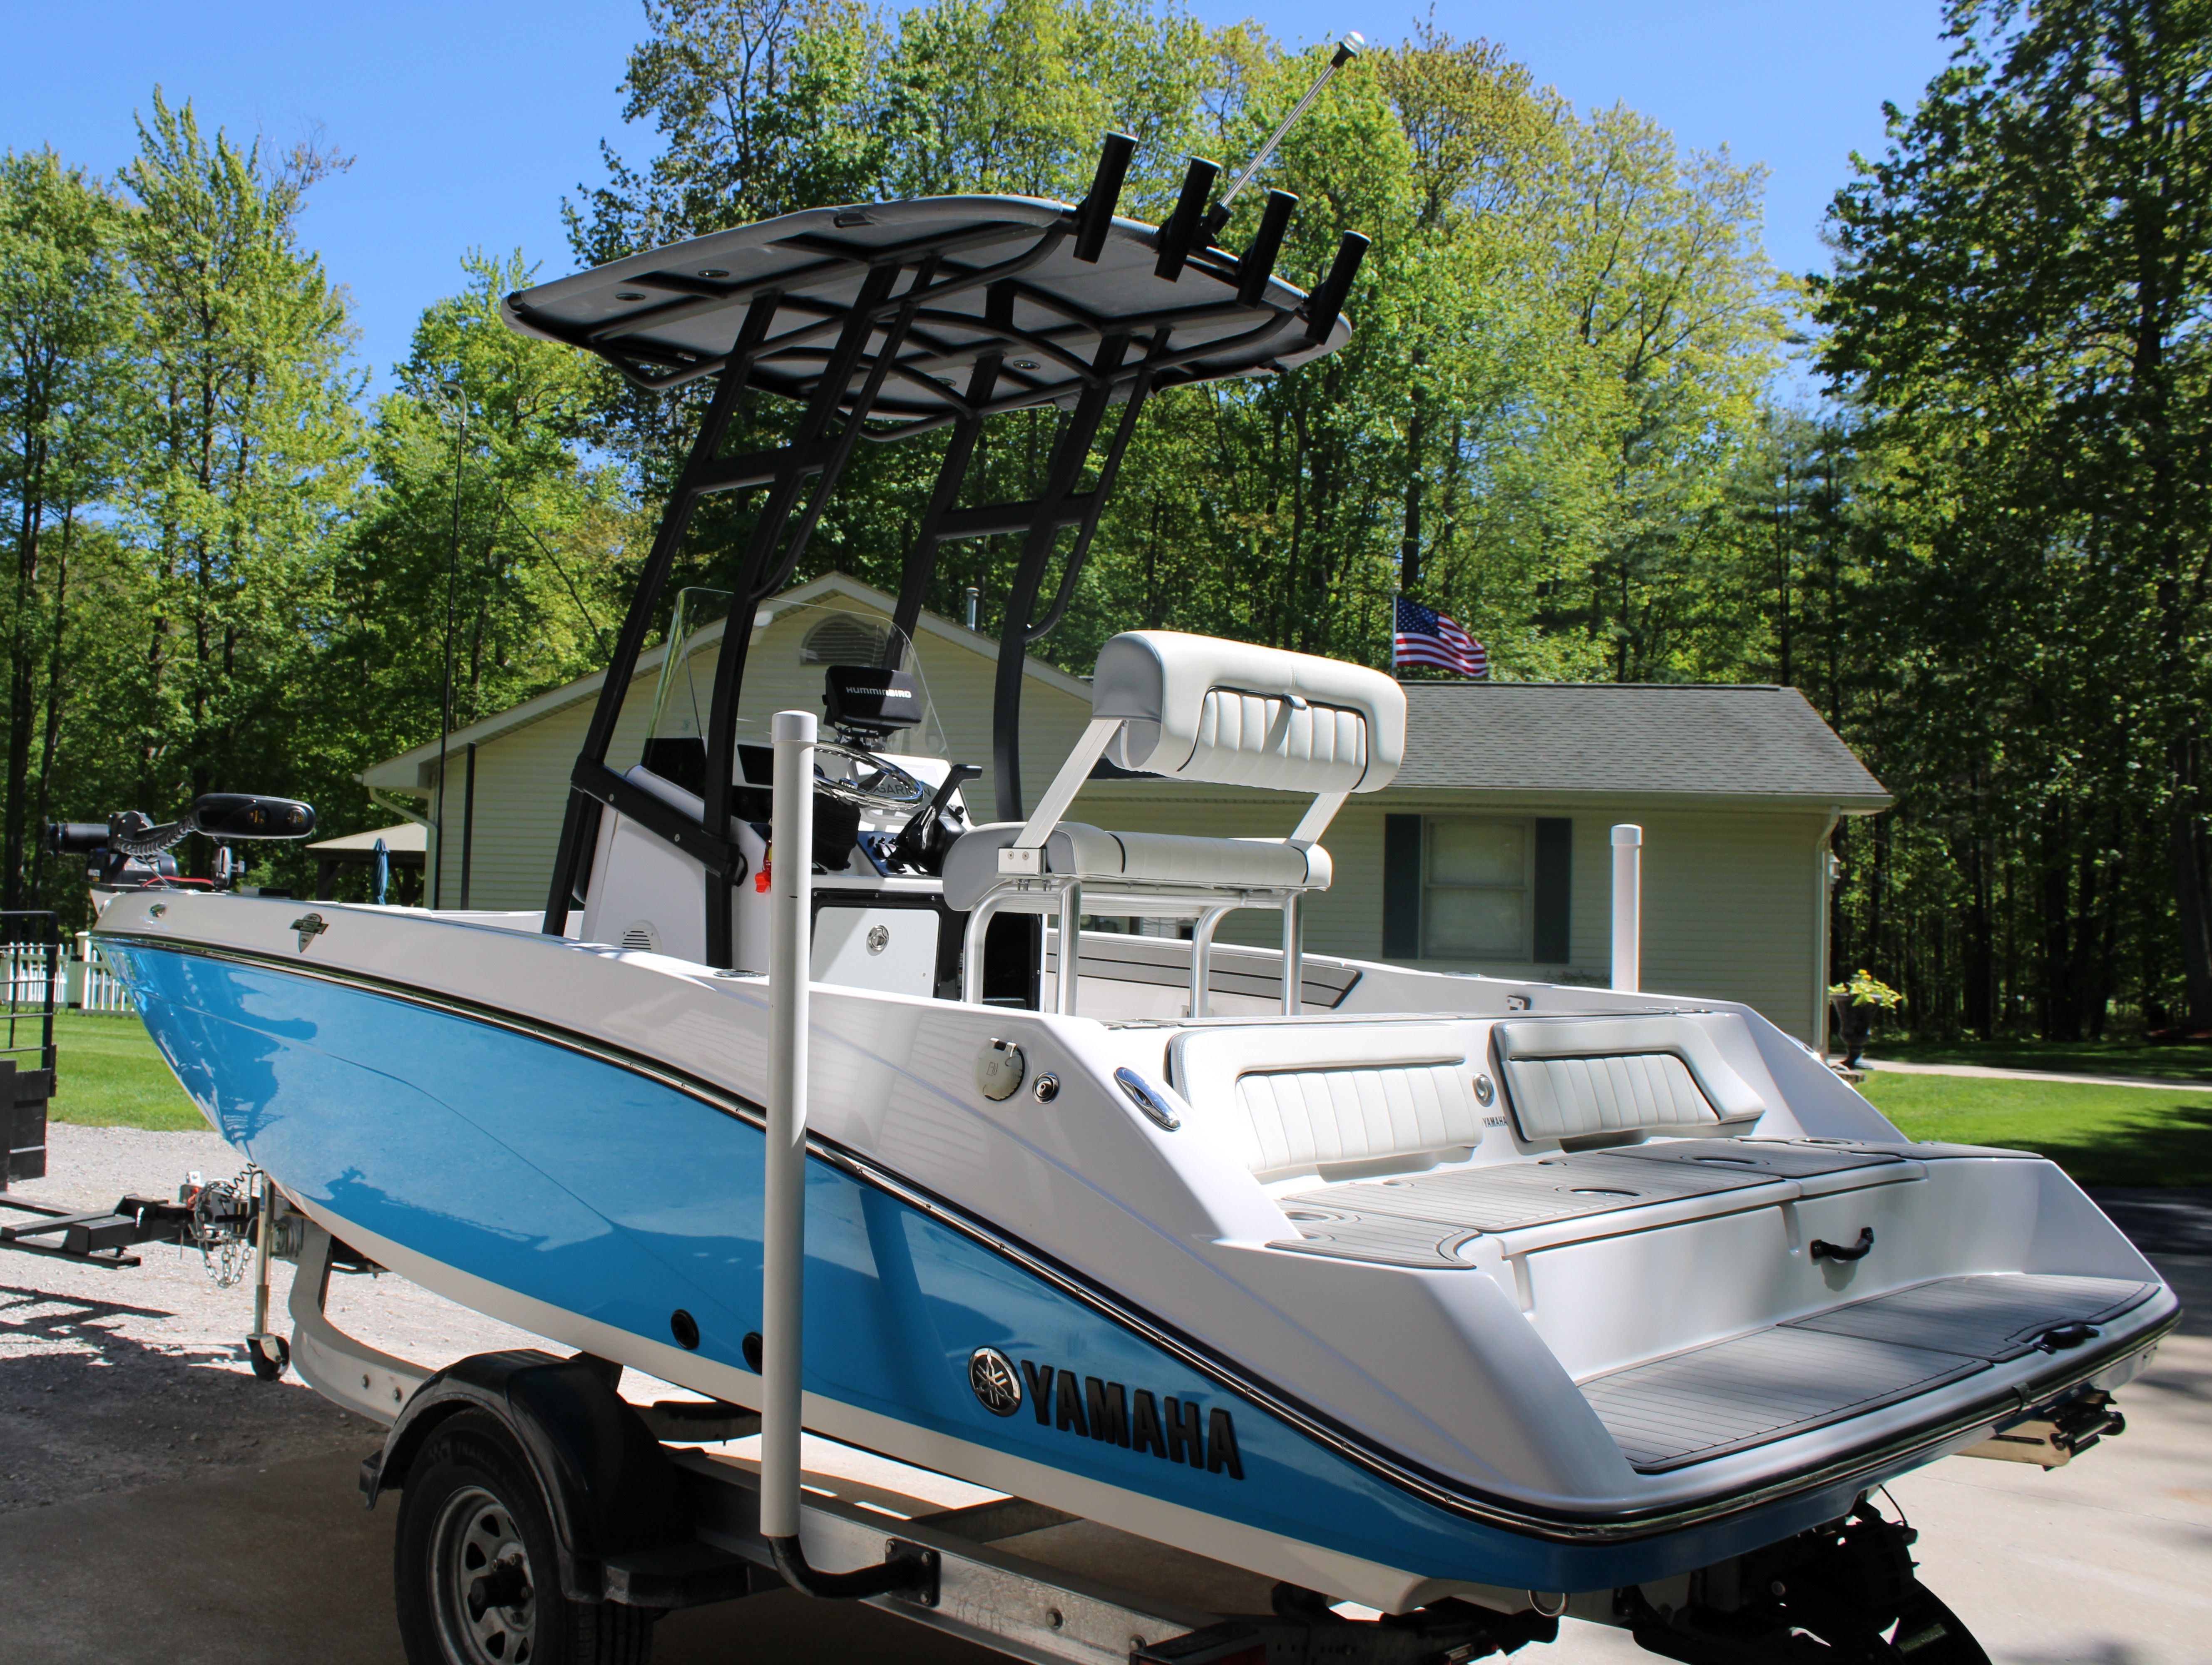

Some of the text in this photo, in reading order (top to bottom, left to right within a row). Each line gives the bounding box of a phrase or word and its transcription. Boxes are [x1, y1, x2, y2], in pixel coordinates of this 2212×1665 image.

[846, 687, 912, 698] HUMMINBIRD
[877, 783, 932, 798] GARN
[1482, 1116, 1508, 1128] YAMAHA
[1020, 1359, 1244, 1481] YAMAHA
